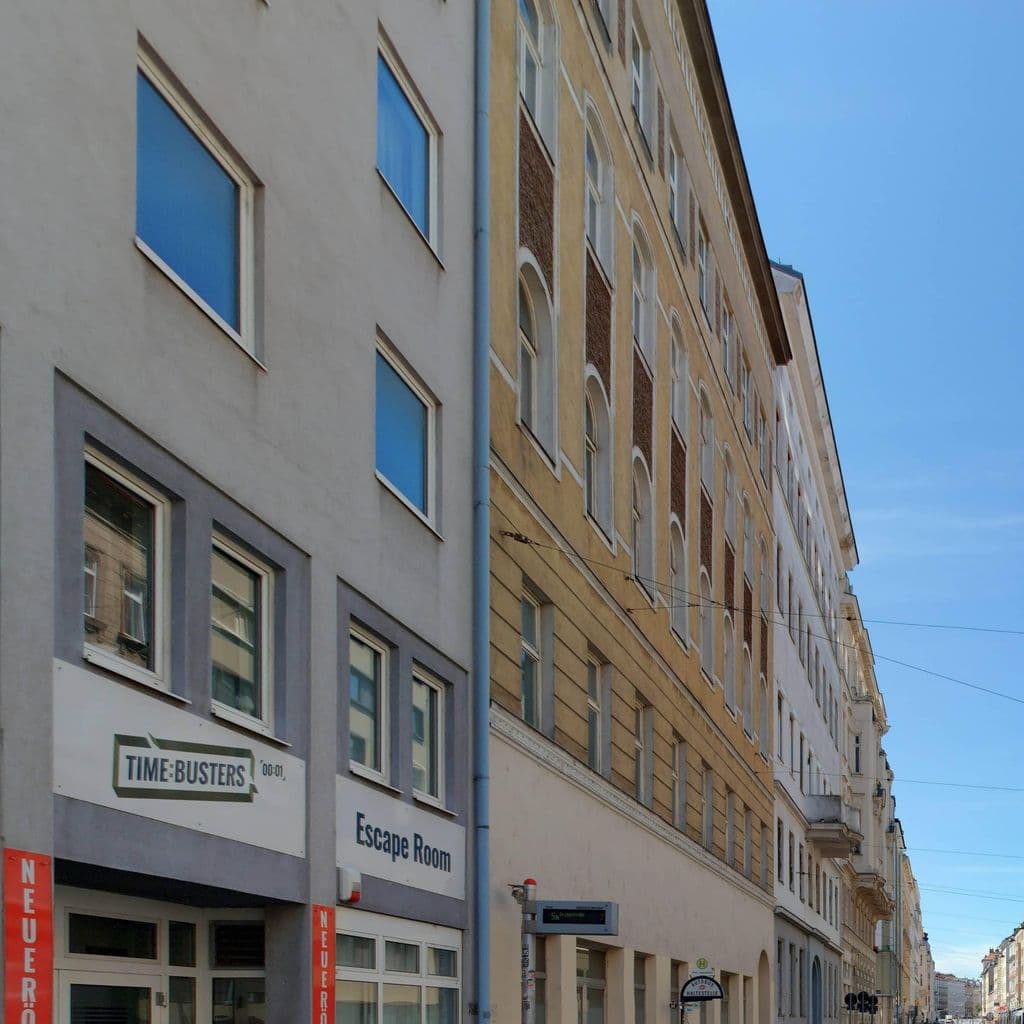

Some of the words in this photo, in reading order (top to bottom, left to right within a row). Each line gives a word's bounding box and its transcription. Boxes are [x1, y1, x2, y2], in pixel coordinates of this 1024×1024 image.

[126, 755, 245, 787] TIME:BUSTERS
[356, 811, 409, 862] Escape
[413, 832, 451, 873] Room
